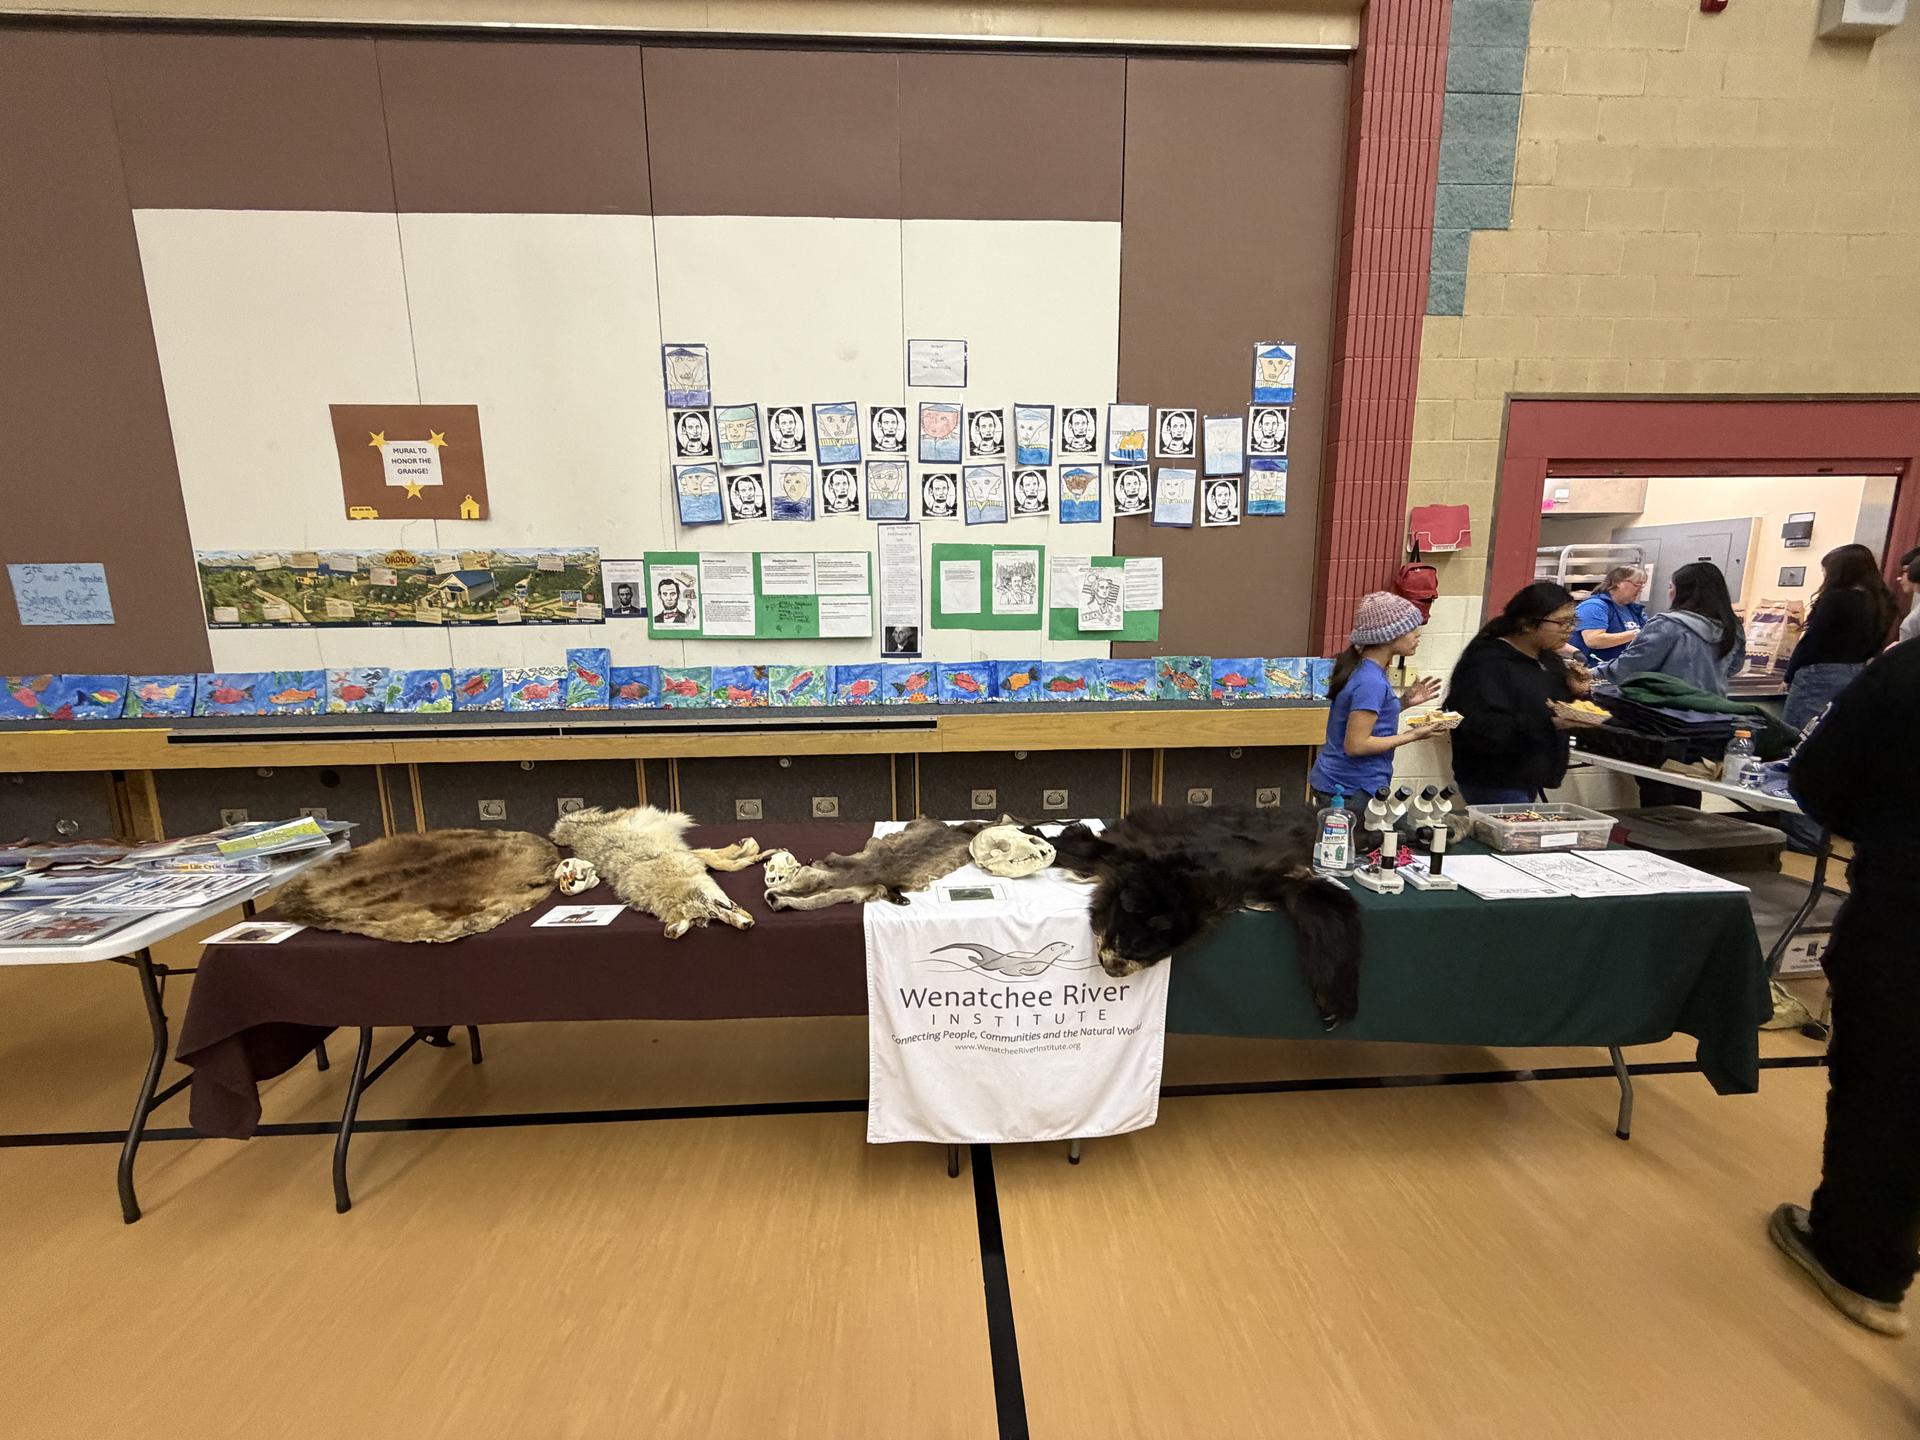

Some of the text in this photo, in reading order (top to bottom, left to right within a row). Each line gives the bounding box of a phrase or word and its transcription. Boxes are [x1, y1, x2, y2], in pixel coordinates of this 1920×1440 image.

[203, 863, 222, 871] Cycle
[899, 983, 1131, 1009] Wenatchee River
[931, 1008, 1107, 1028] INSTITUTE
[891, 1031, 941, 1045] Connecting
[943, 1029, 978, 1041] People,
[980, 1030, 1041, 1043] Communities
[1042, 1029, 1061, 1039] and
[1063, 1027, 1079, 1038] the
[1080, 1025, 1115, 1036] Natural
[954, 1043, 1082, 1055] www.WenatcheeRiverInstitute.org
